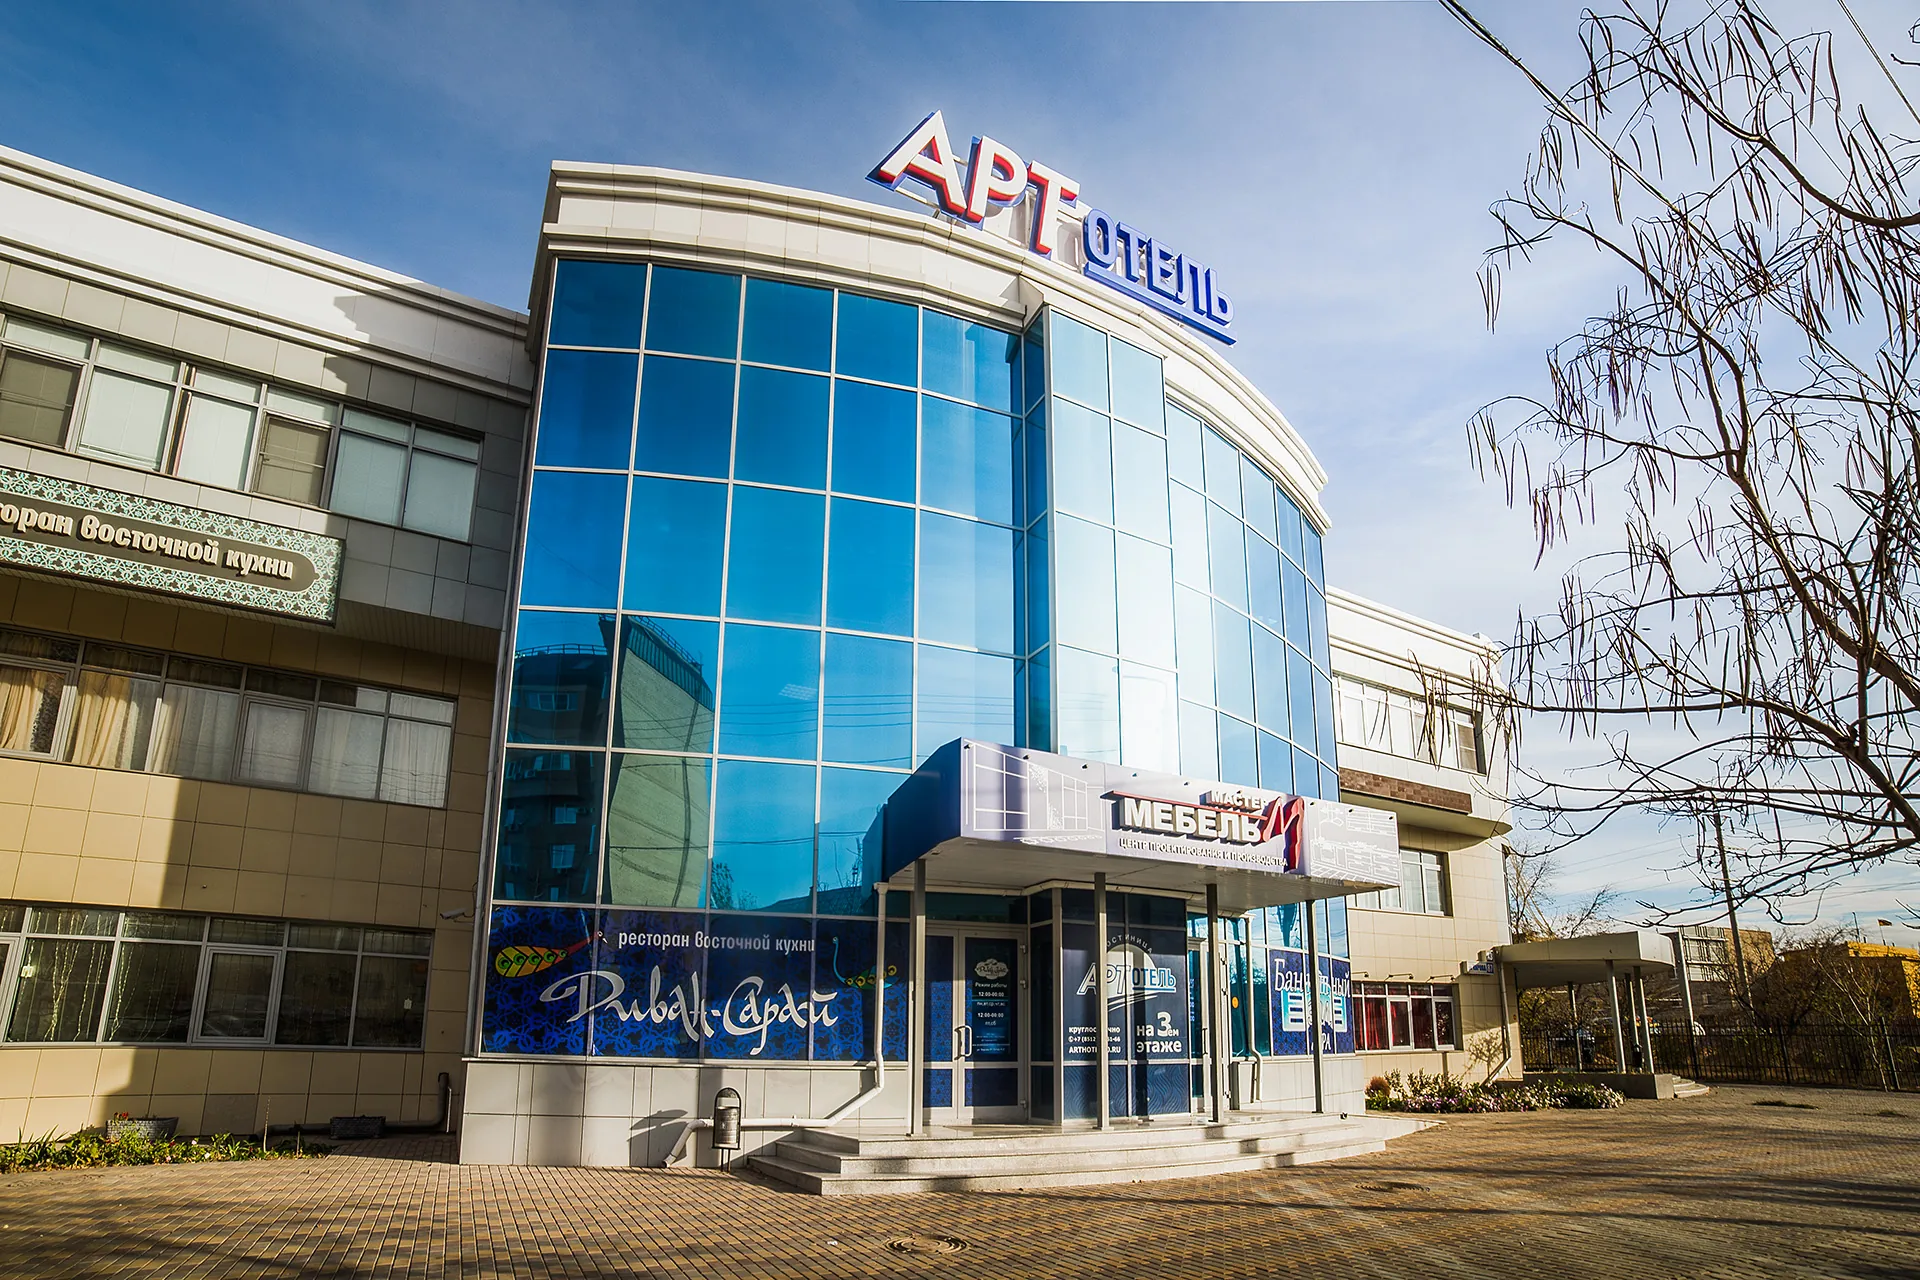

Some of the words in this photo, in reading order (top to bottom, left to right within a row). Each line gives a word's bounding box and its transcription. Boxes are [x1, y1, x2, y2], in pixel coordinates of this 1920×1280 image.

[866, 109, 1080, 259] АРТ
[1083, 208, 1234, 326] ОТЕЛЬ
[0, 502, 73, 536] оран
[226, 549, 294, 580] кухни
[1206, 790, 1268, 811] МАСТЕР
[1121, 797, 1262, 843] МЕБЕЛЬ
[1119, 838, 1149, 850] ЦЕНТР
[1150, 841, 1222, 860] ПРОЕКТИРОВАНИЯ
[1223, 852, 1229, 860] И
[1230, 852, 1288, 867] ПРОИЗВОДСТВА
[618, 930, 689, 949] ресторан
[694, 929, 771, 951] восточной
[775, 936, 816, 955] кухни
[1107, 933, 1154, 953] ОСТИНИЦА
[1131, 967, 1176, 988] ОТЕЛЬ
[539, 965, 839, 1056] Диван-Сарай
[1068, 1026, 1121, 1035] круглосчно
[1136, 1024, 1155, 1037] на
[1136, 1040, 1183, 1054] этаже
